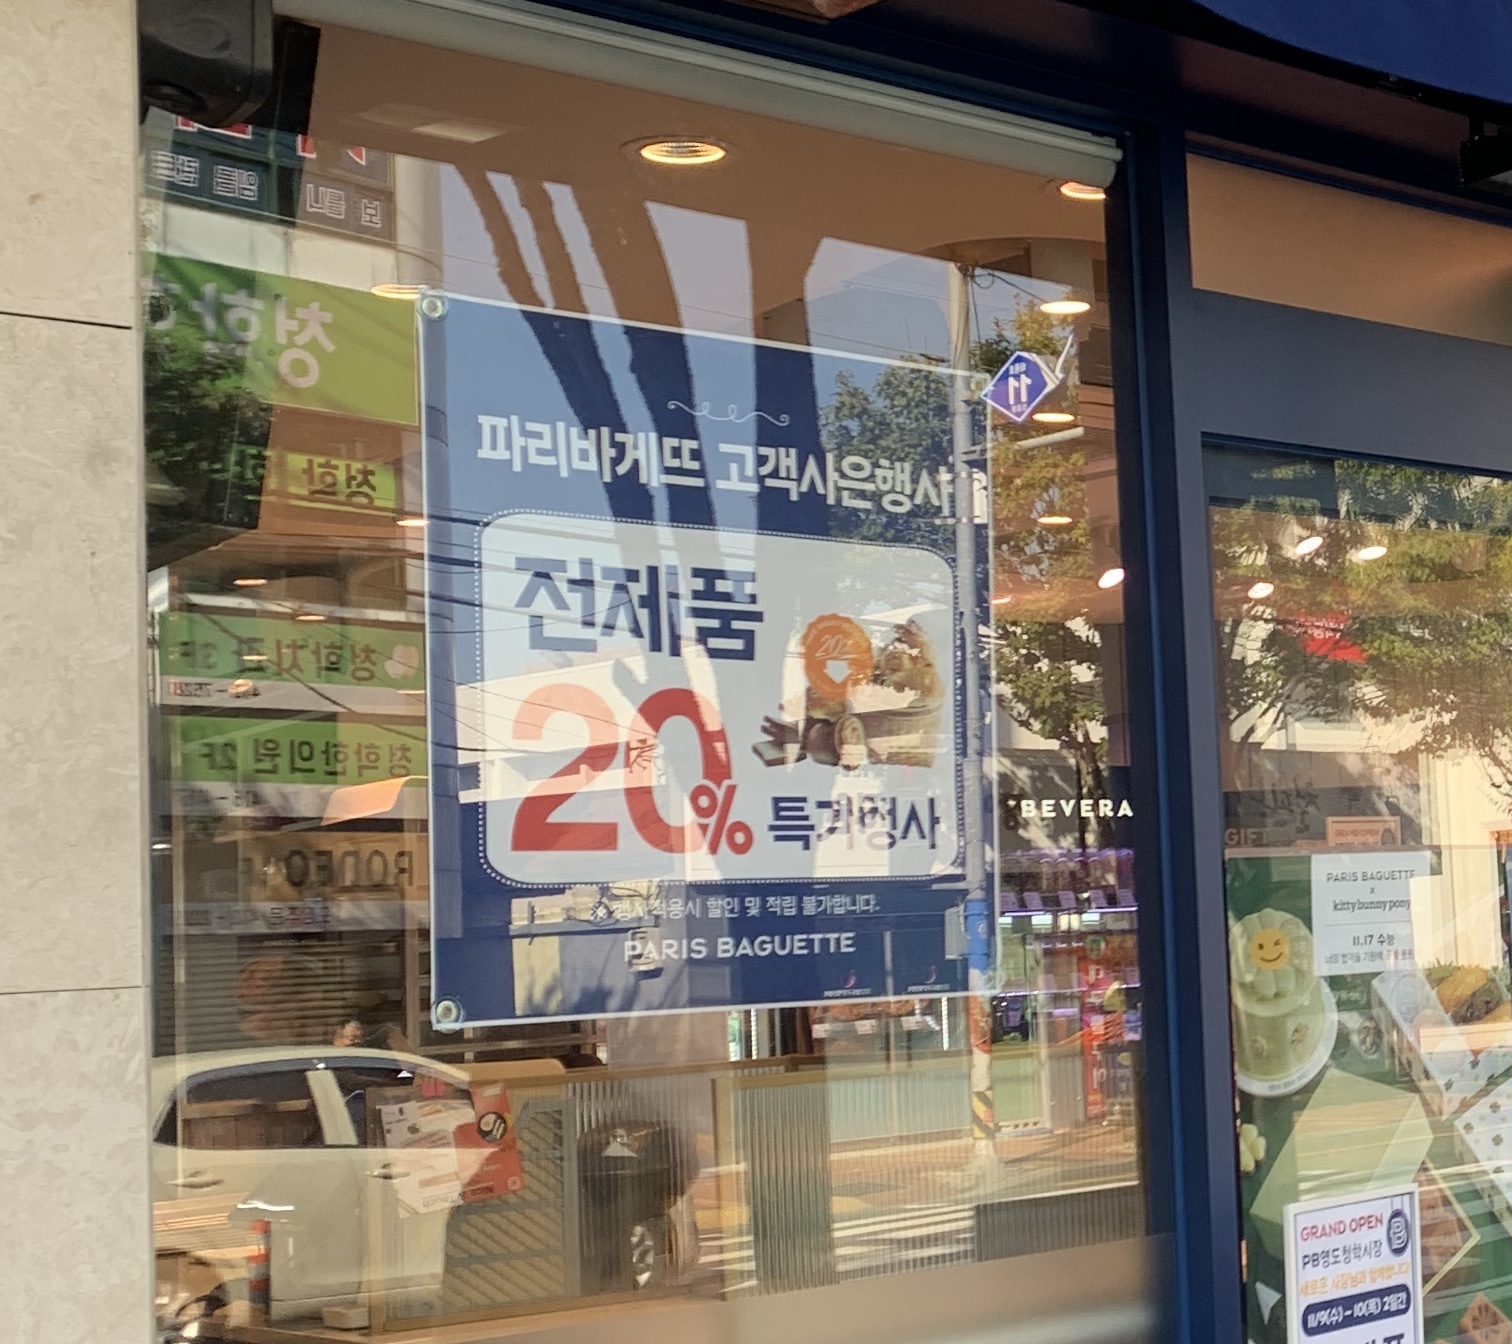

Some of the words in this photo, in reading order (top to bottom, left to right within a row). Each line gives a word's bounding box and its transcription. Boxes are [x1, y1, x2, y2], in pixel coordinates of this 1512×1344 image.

[475, 413, 706, 490] 파리바게뜨
[714, 440, 953, 519] 고객사은행사
[513, 552, 764, 661] 전제품
[509, 682, 754, 857] 20%
[1020, 798, 1134, 818] BEVERA
[1326, 871, 1359, 883] PARIS
[623, 937, 709, 962] PARIS
[716, 931, 856, 959] BAGUETTE
[1300, 1220, 1346, 1242] GRAND
[1348, 1213, 1384, 1233] OPEN
